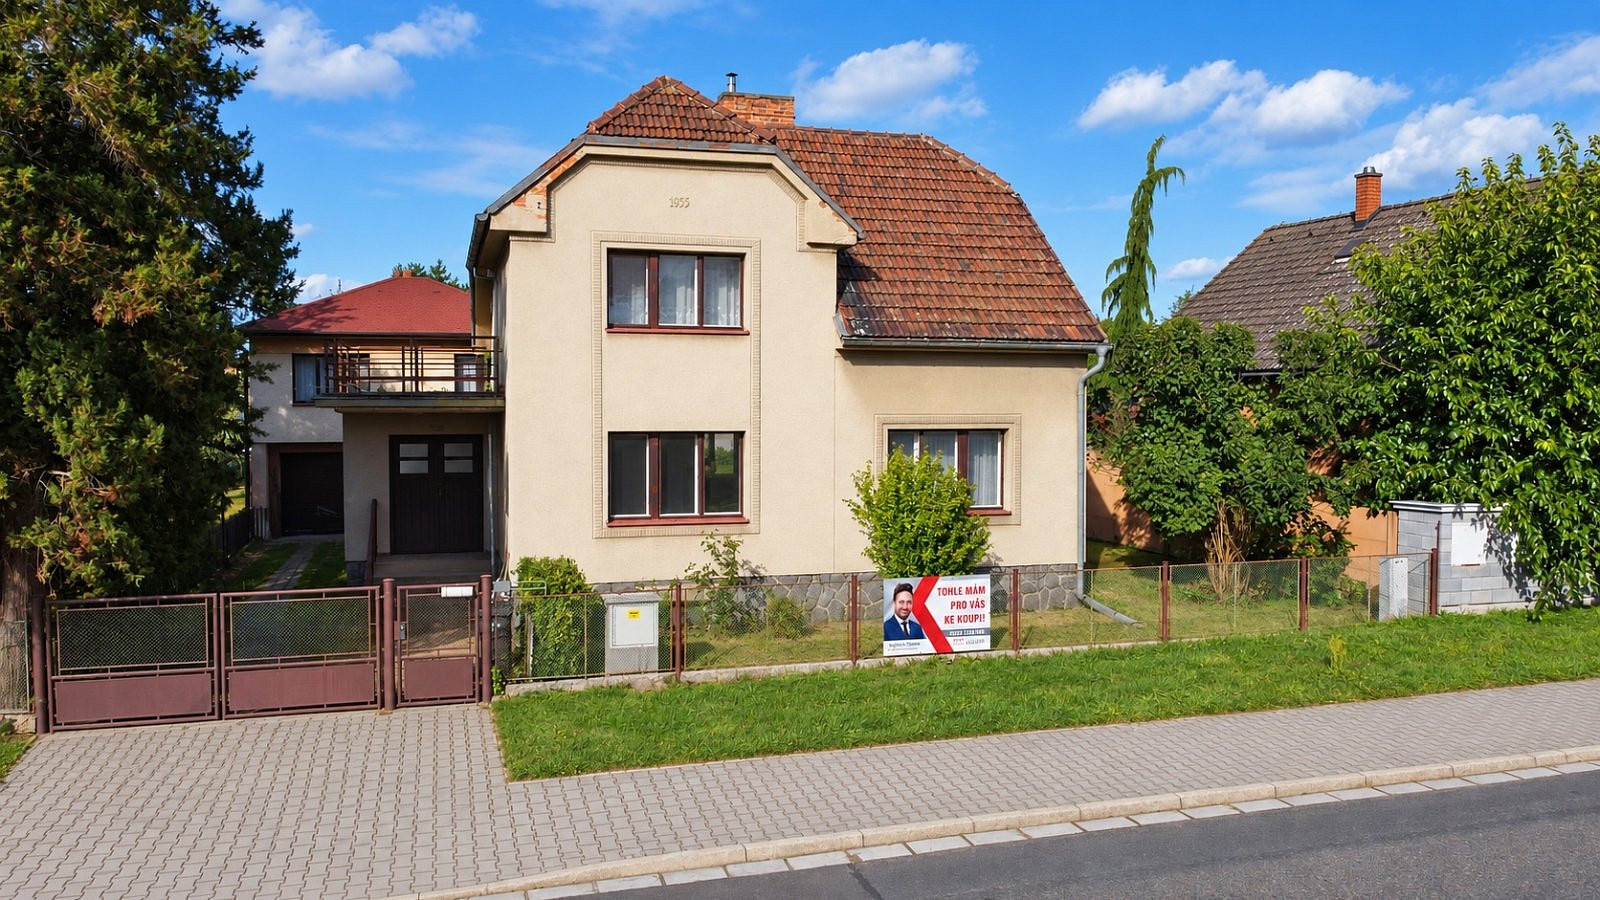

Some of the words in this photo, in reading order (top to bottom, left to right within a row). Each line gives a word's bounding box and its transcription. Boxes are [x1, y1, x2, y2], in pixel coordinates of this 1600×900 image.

[669, 197, 690, 208] 1955
[937, 586, 963, 596] TOHLE
[965, 584, 986, 595] MÁM
[950, 601, 967, 610] PRO
[969, 598, 986, 609] VÁS
[944, 615, 954, 624] KE
[957, 614, 986, 624] KOUPI!
